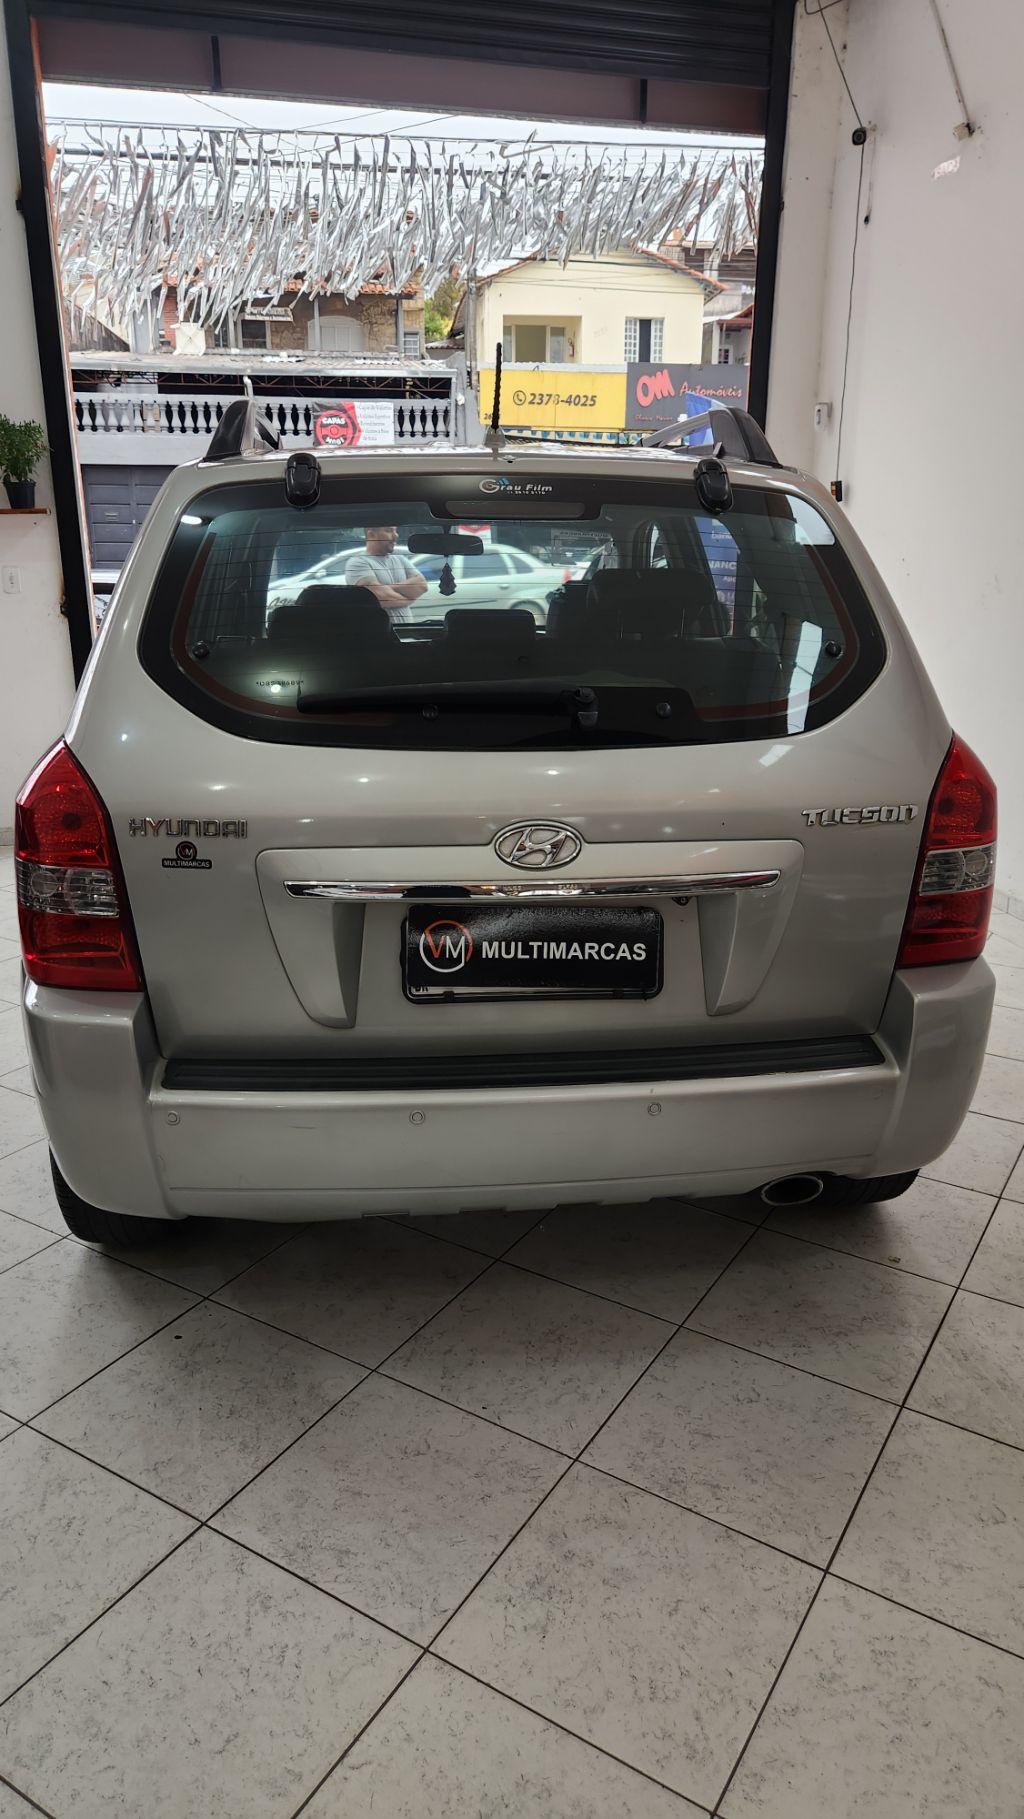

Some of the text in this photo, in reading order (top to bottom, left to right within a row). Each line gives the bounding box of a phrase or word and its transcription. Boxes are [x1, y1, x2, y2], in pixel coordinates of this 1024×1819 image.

[321, 417, 346, 425] CAPAS
[802, 804, 918, 826] TUCSON
[128, 817, 248, 838] HYUNDAI
[163, 859, 210, 868] MULTIMARCAS
[481, 940, 647, 961] MULTIMARCAS
